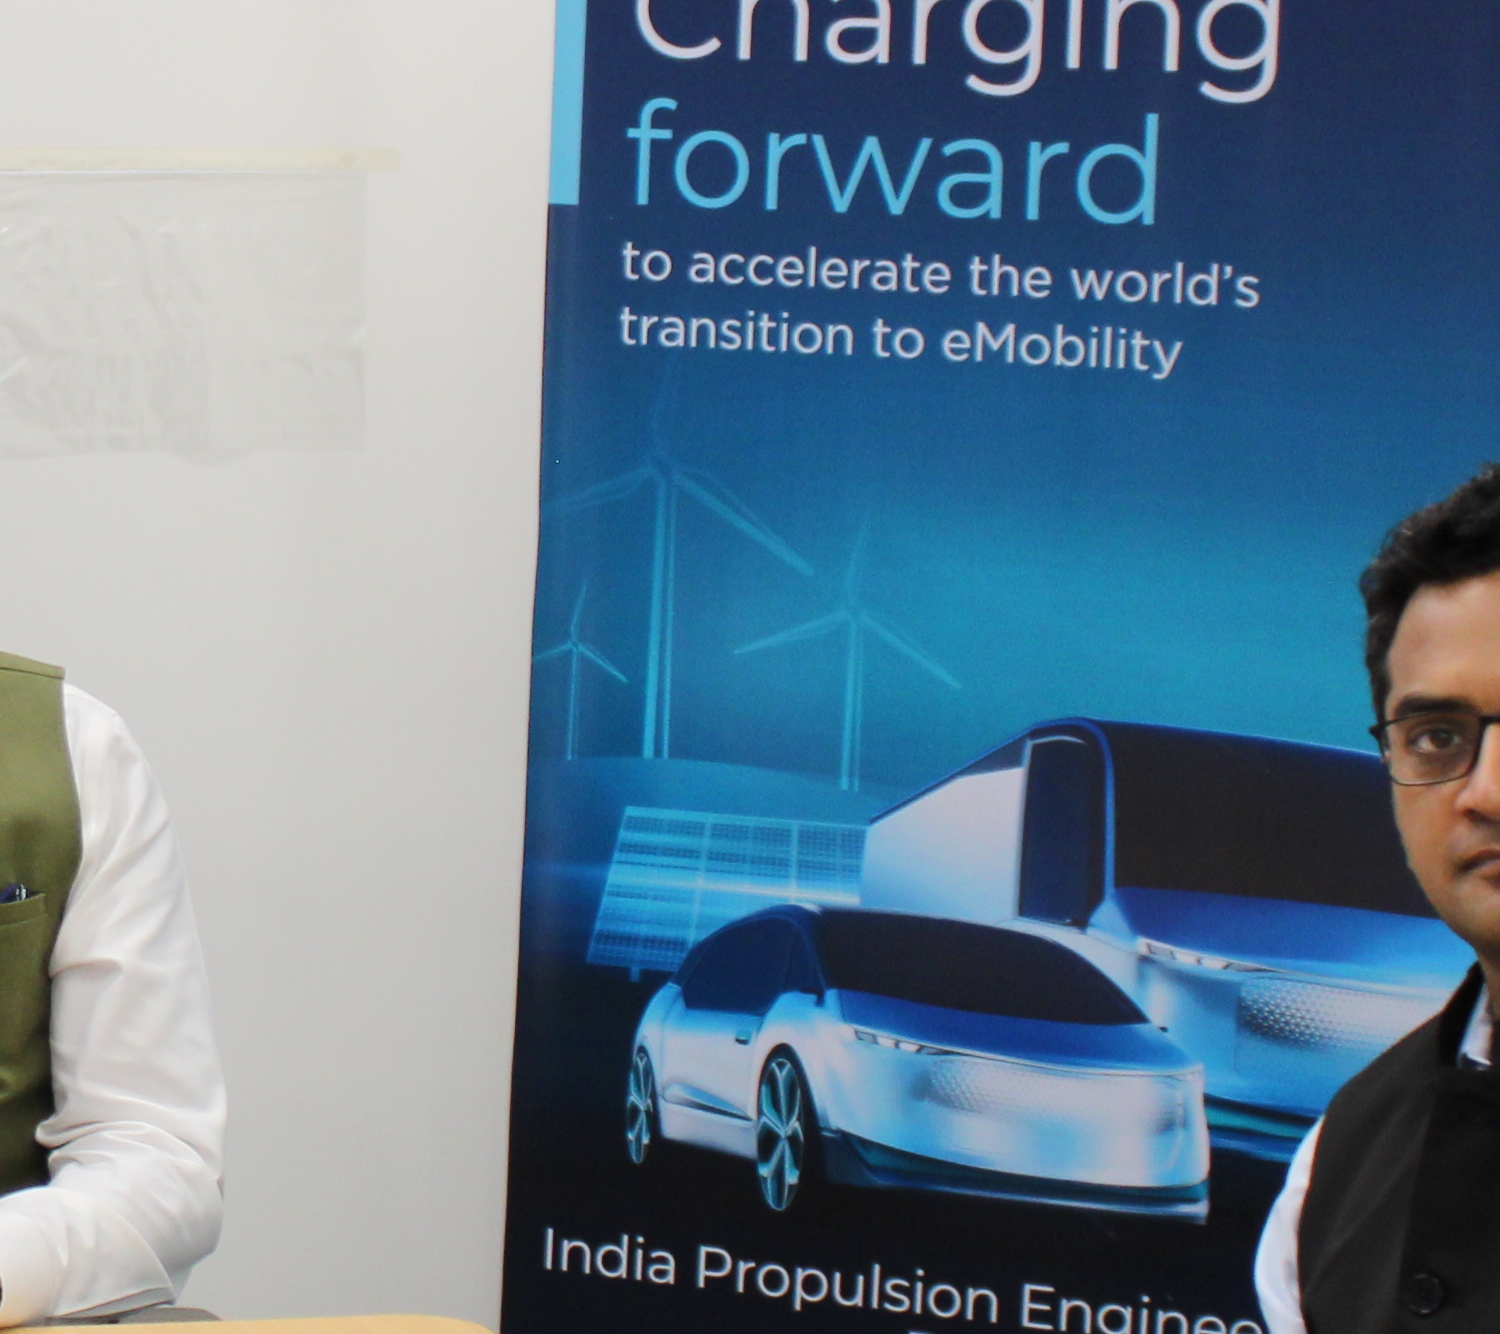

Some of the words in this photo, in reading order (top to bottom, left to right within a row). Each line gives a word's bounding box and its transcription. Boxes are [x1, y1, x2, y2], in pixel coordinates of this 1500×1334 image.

[626, 97, 1160, 226] forward
[622, 241, 672, 281] to
[689, 246, 952, 294] accelerate
[969, 253, 1053, 298] the
[1071, 261, 1260, 308] world’s
[620, 306, 854, 355] transition
[873, 318, 925, 359] to
[942, 321, 1183, 380] eMobility
[546, 1228, 676, 1285] India
[698, 1246, 998, 1324] Propulsion
